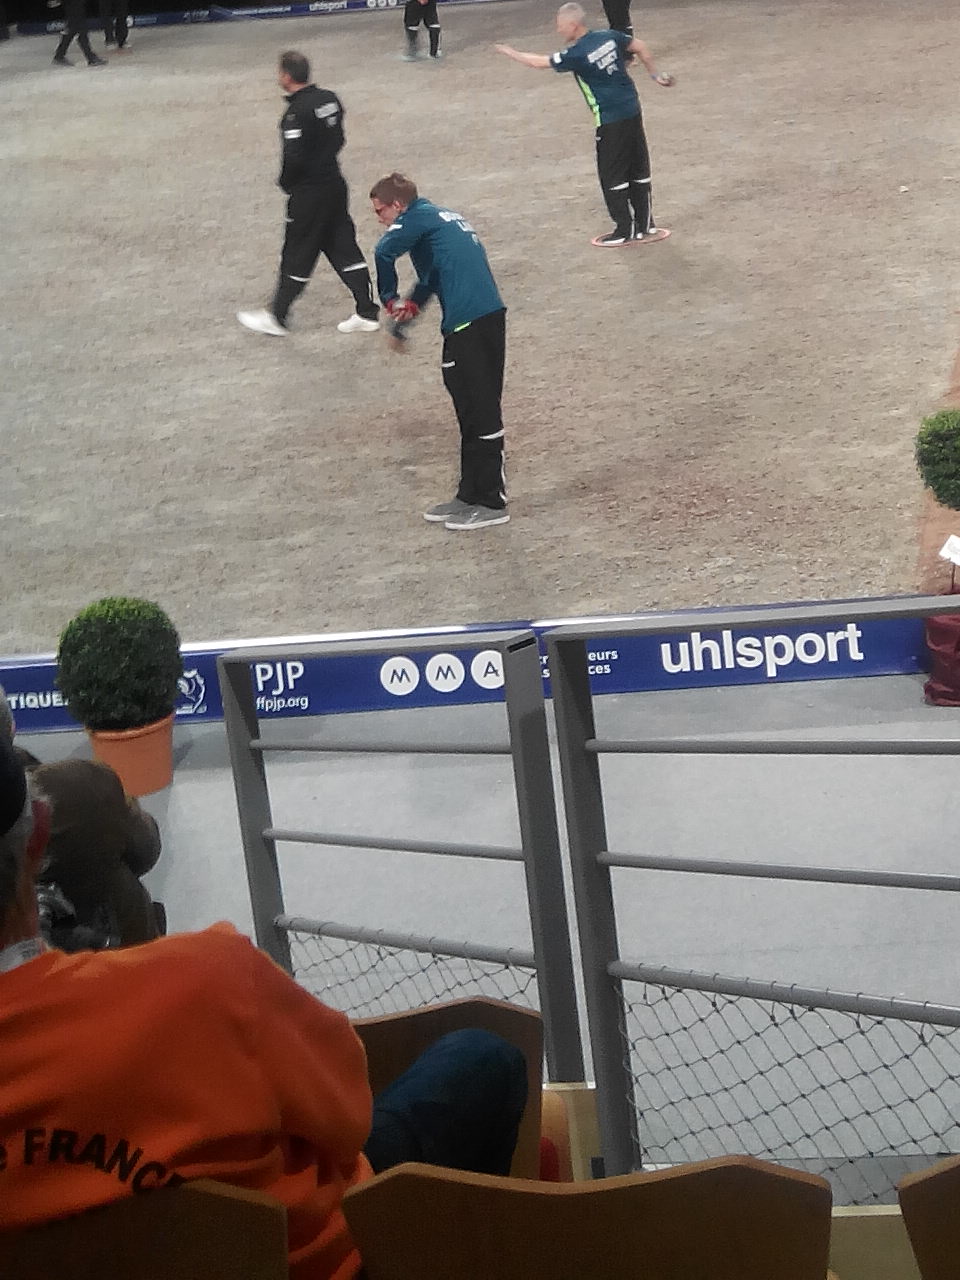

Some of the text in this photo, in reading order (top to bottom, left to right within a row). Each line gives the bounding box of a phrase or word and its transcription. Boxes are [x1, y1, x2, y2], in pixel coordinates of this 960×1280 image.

[250, 660, 305, 696] PJP
[660, 622, 864, 678] uhlsport
[23, 1126, 186, 1194] FRANC
